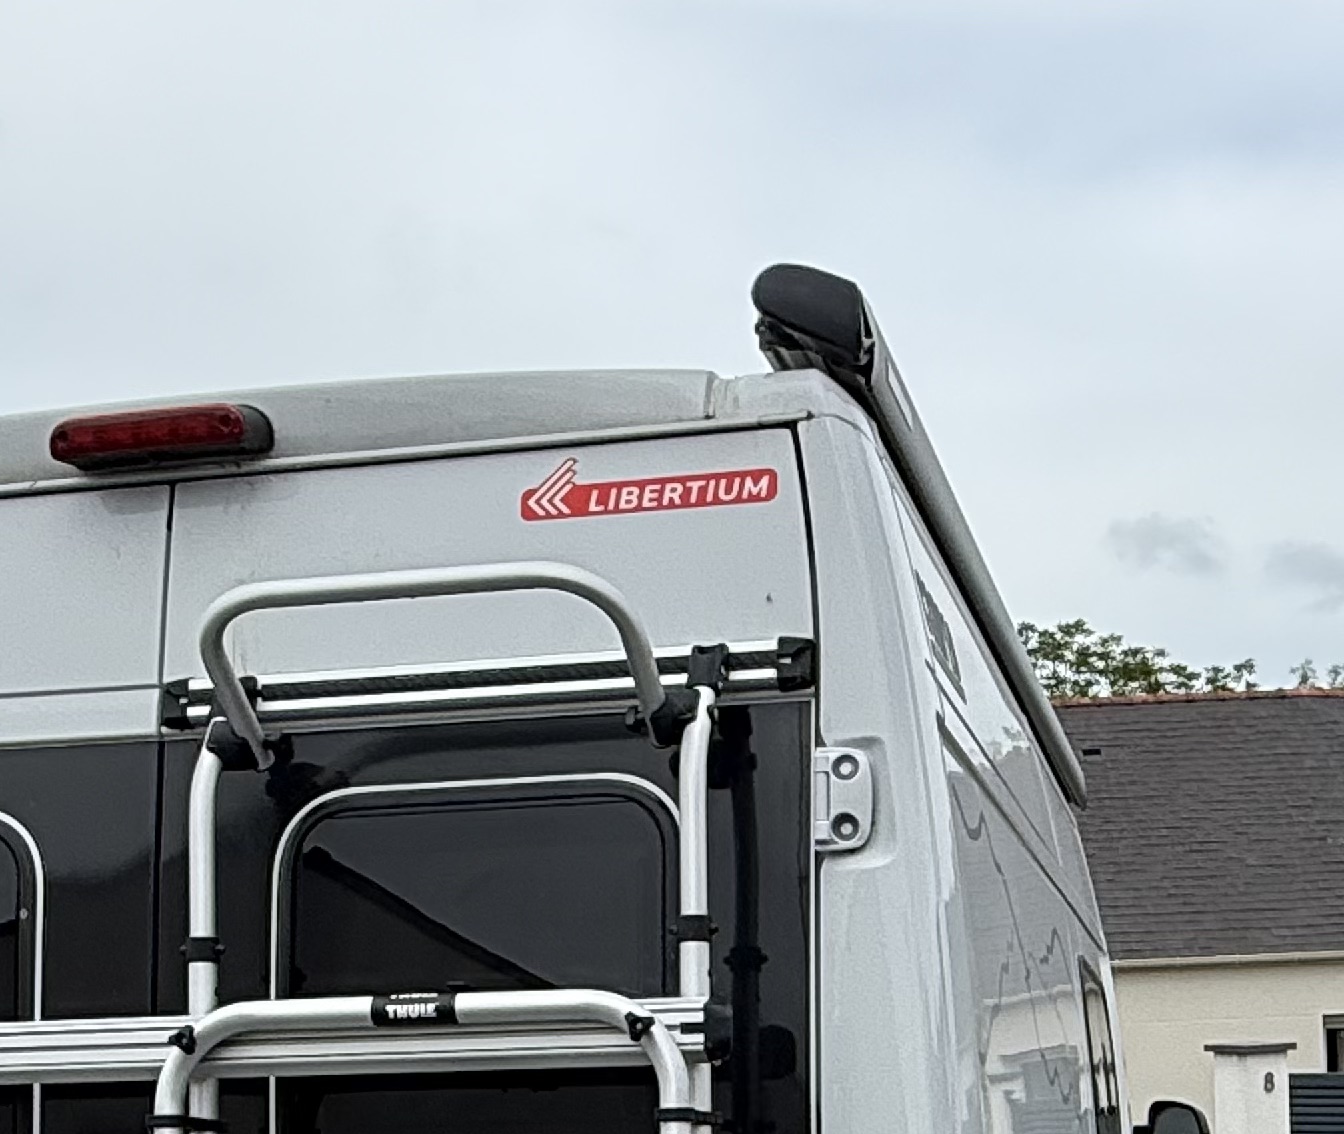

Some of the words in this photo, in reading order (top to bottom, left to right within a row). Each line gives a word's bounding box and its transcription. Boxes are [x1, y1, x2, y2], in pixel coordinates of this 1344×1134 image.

[588, 475, 770, 512] LIBERTIUM
[385, 1003, 439, 1019] THULE
[1264, 1071, 1275, 1093] 8
